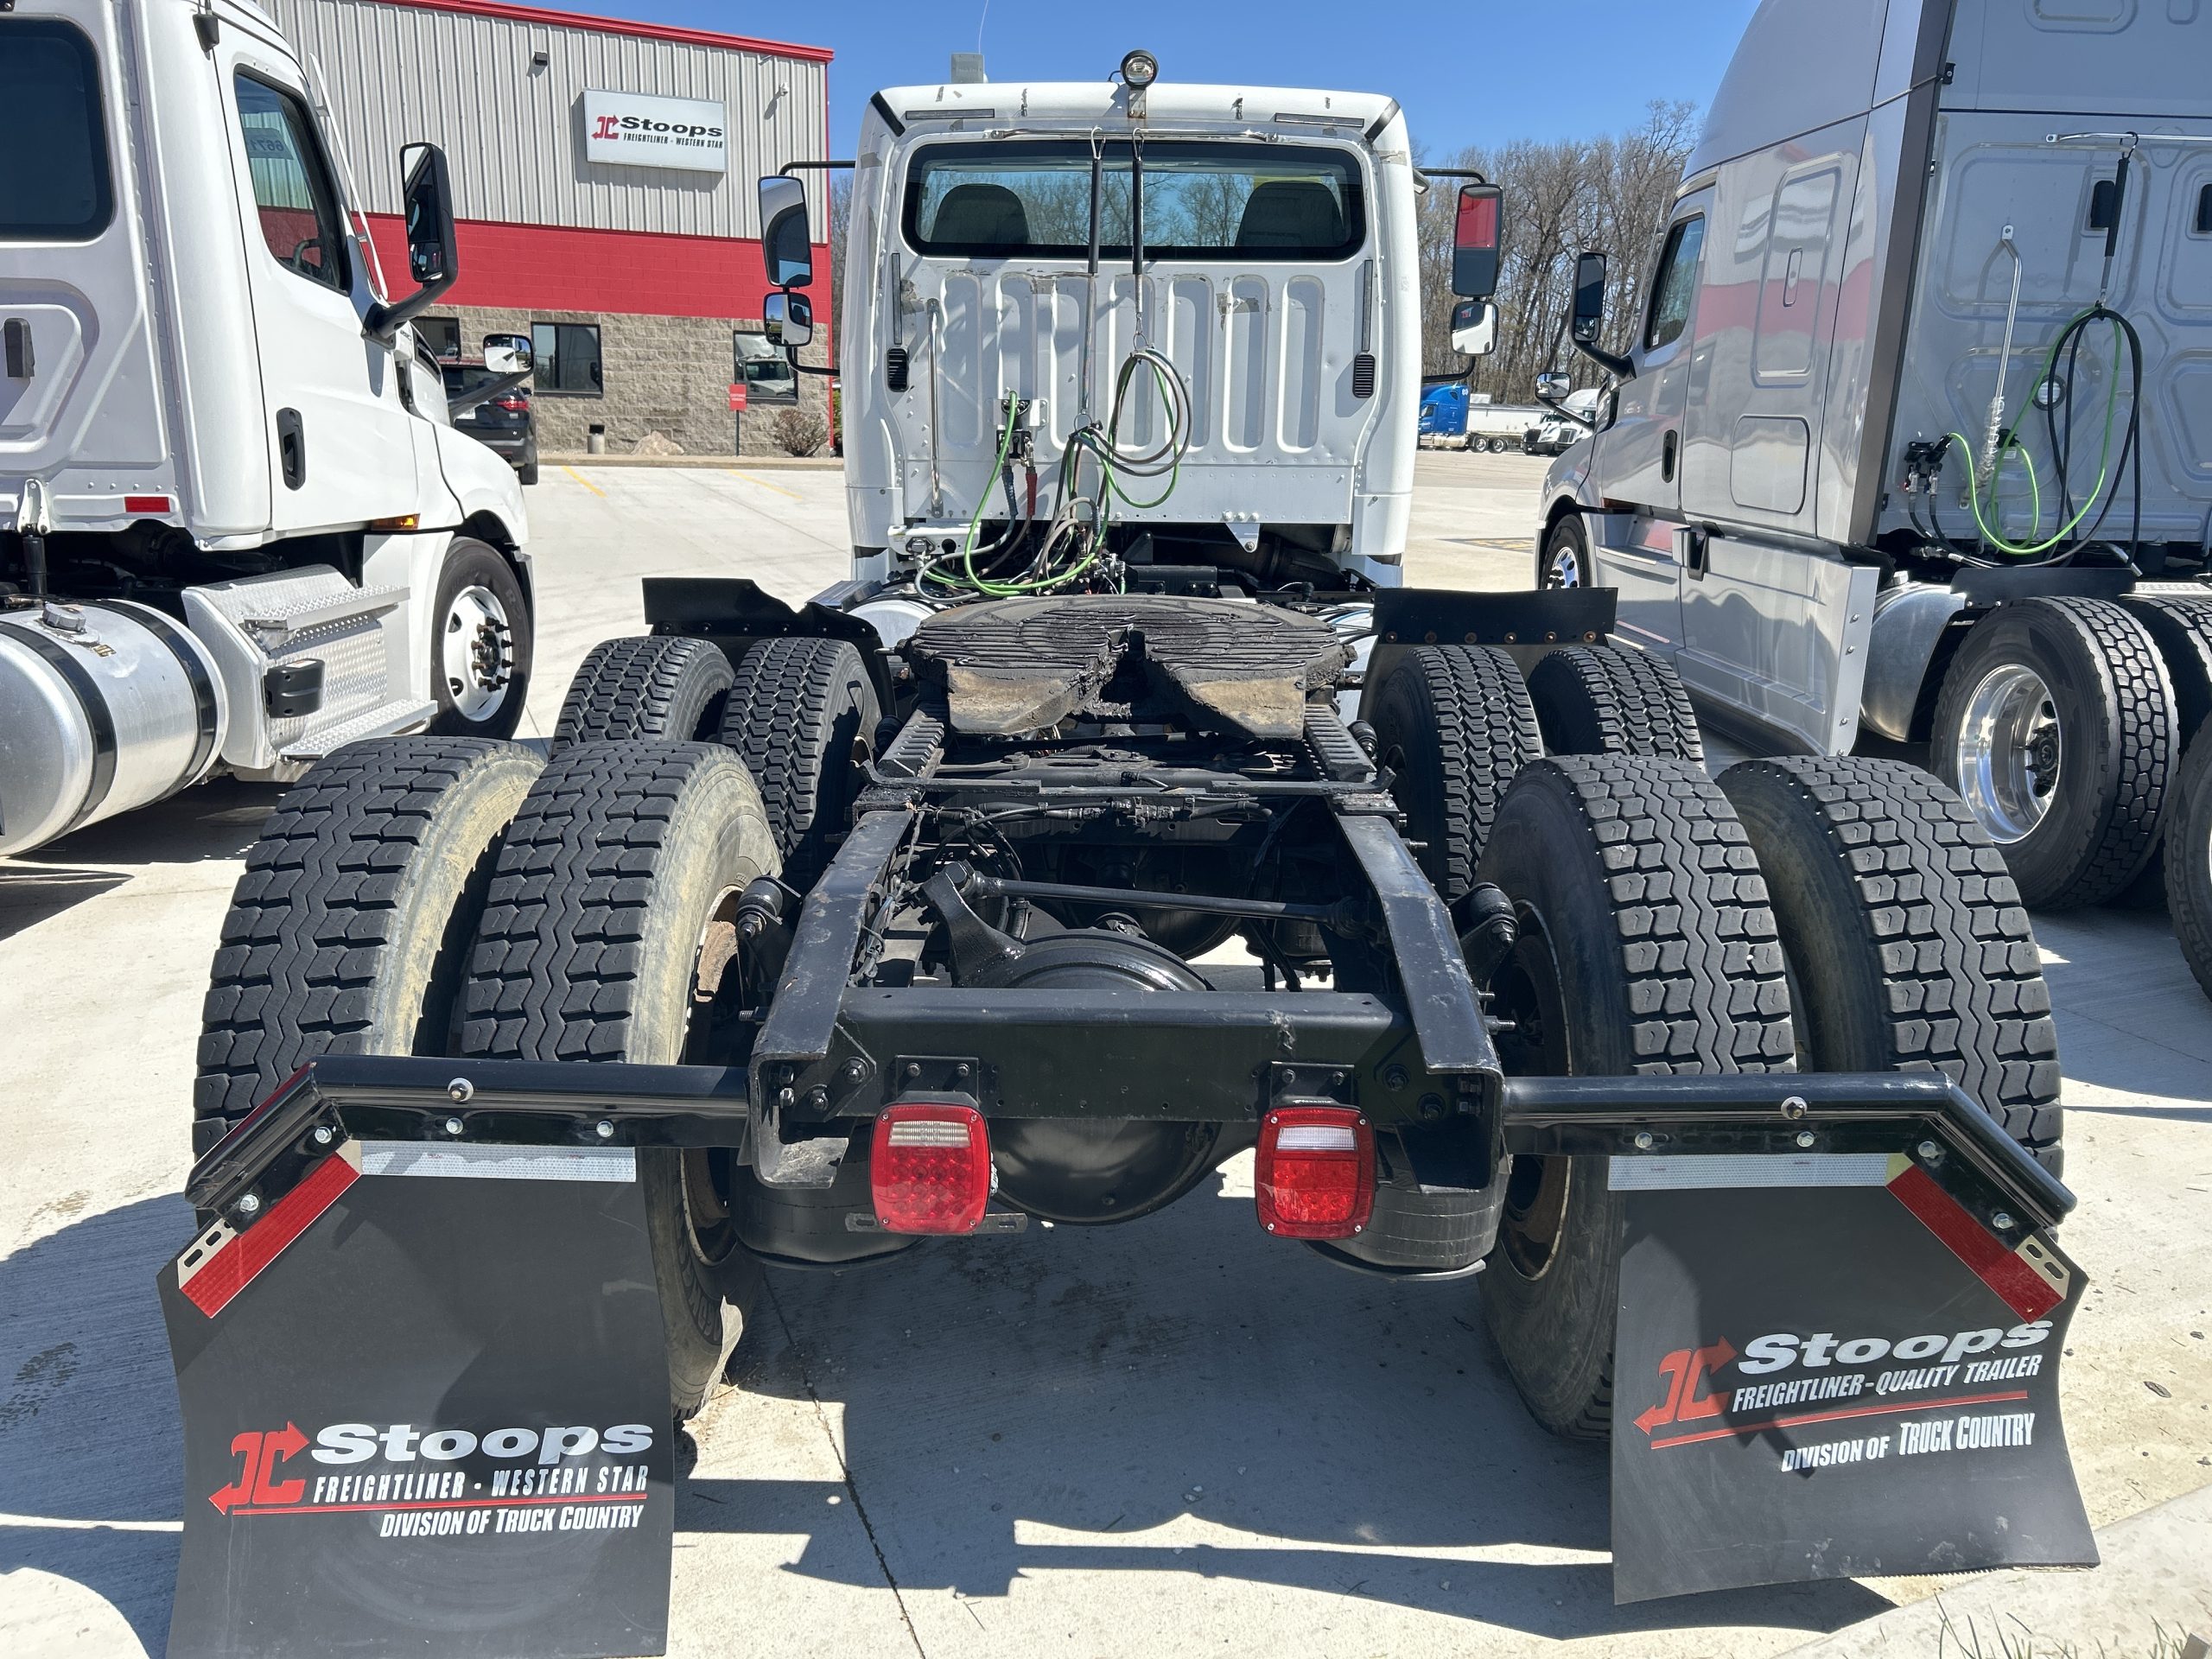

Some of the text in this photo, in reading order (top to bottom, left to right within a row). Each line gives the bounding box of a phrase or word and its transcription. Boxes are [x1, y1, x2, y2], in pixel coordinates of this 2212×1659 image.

[620, 116, 723, 137] Stoops
[623, 132, 669, 145] FREIGHTLINER
[676, 137, 705, 148] WESTERN
[707, 140, 723, 149] STAR
[1737, 1319, 2055, 1375] Stoops
[1962, 1354, 2044, 1383] TRAILER
[310, 1422, 654, 1465] Stoops
[1780, 1412, 2036, 1473] DIVISION OF TRUCK COUNTRY
[313, 1471, 466, 1504] FREIGHTLINER
[490, 1467, 589, 1497] WESTERN
[595, 1465, 650, 1494] STAR
[378, 1503, 645, 1538] DIVISION OF TRUCK COUNTRY
